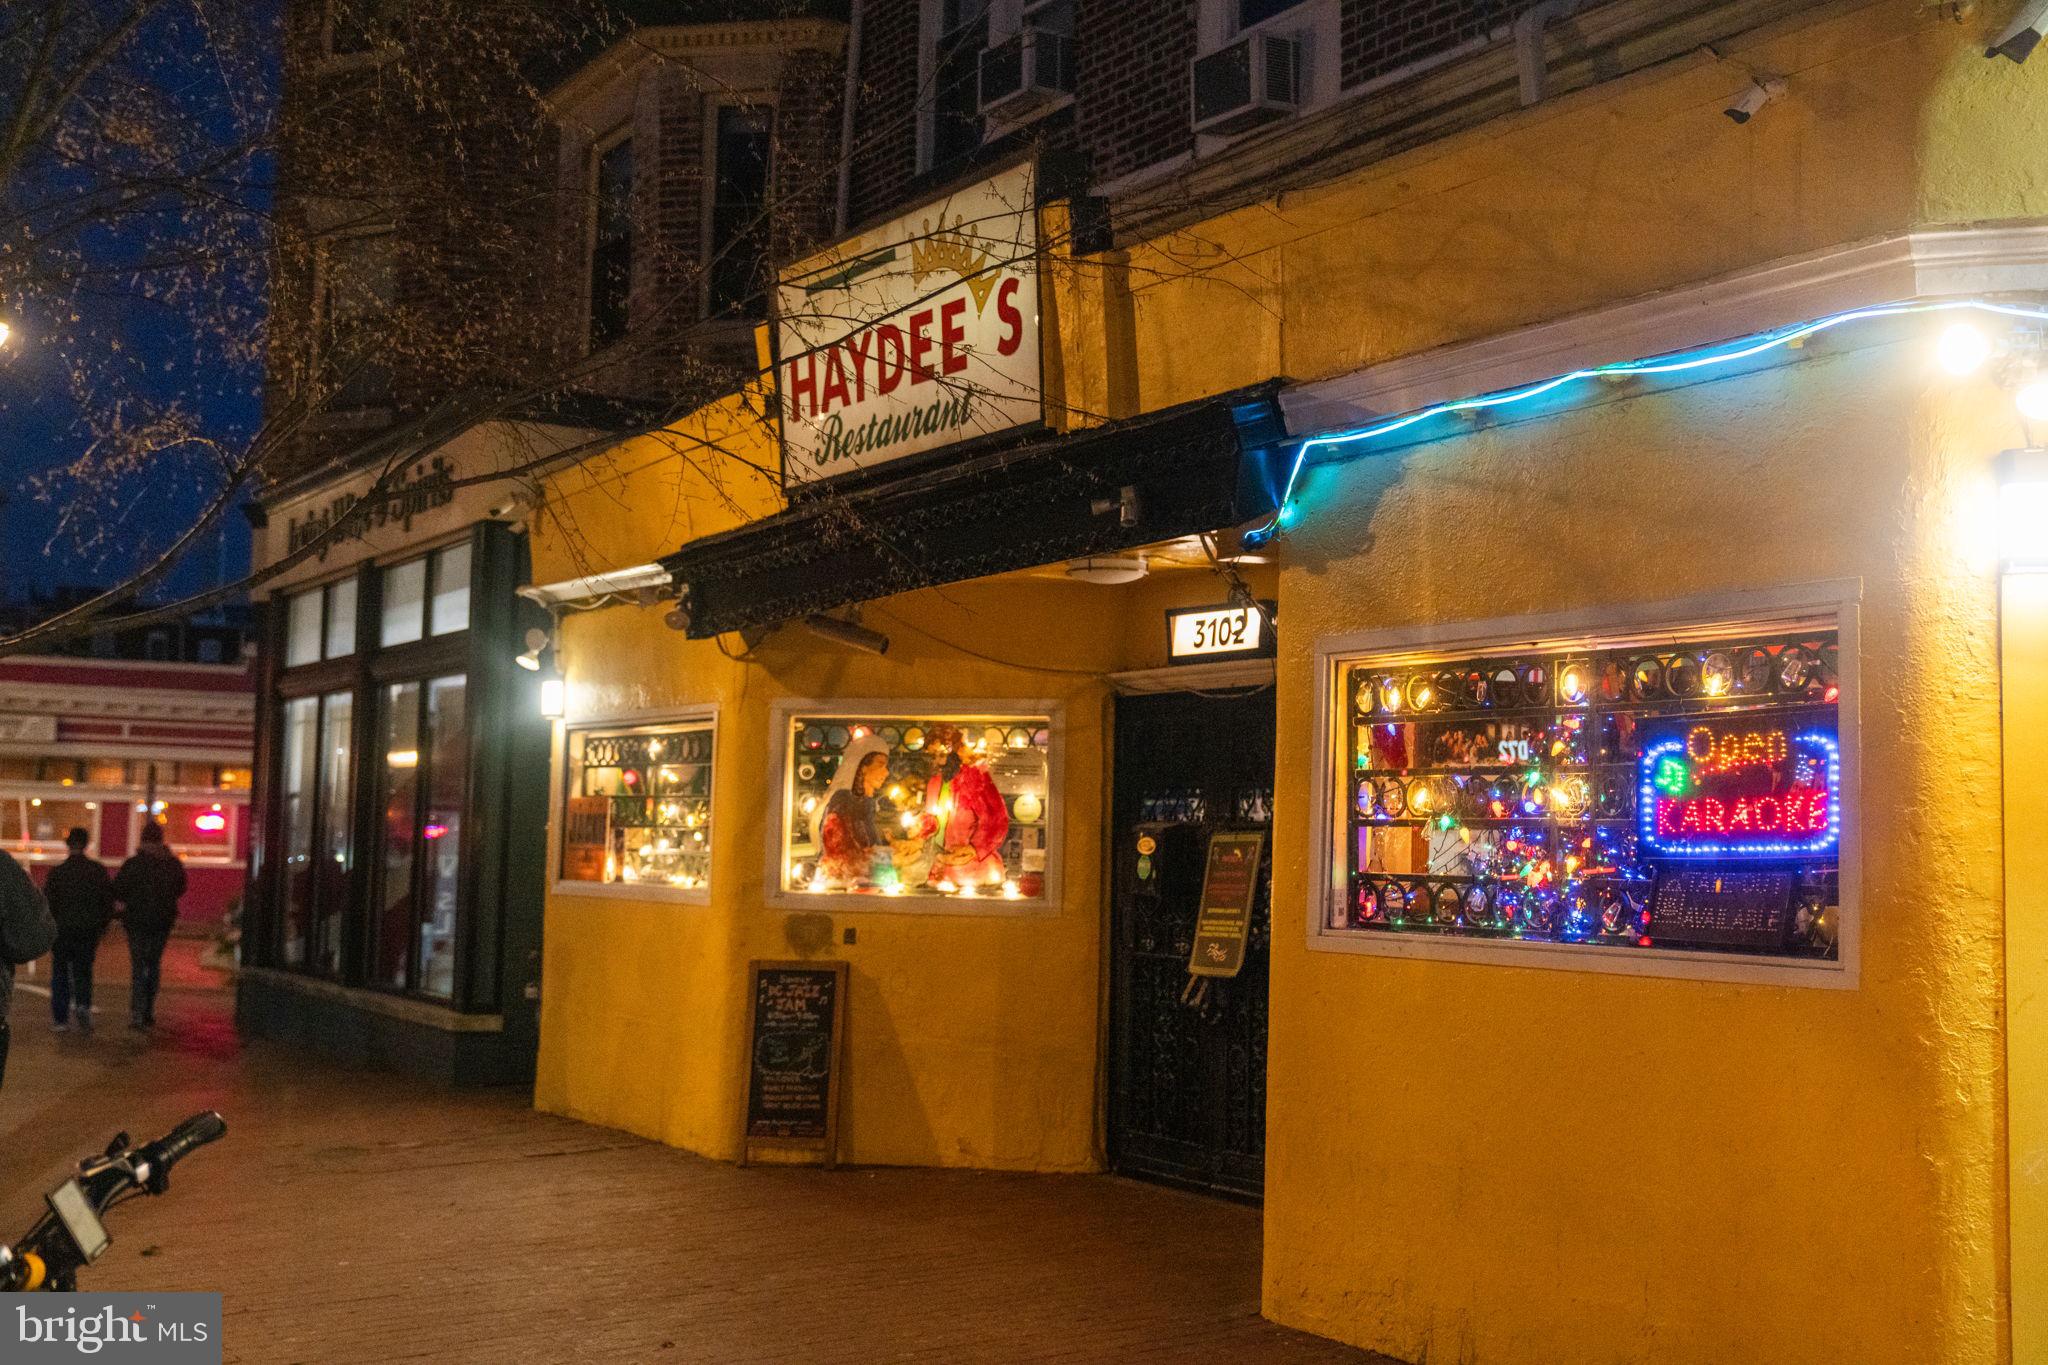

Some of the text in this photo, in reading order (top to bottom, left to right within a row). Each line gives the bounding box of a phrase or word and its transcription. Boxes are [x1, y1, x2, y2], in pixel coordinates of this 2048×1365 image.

[815, 391, 974, 466] Restaurant
[1193, 614, 1247, 649] 3102
[1688, 725, 1787, 770] Open
[1657, 792, 1828, 836] KARAOKE
